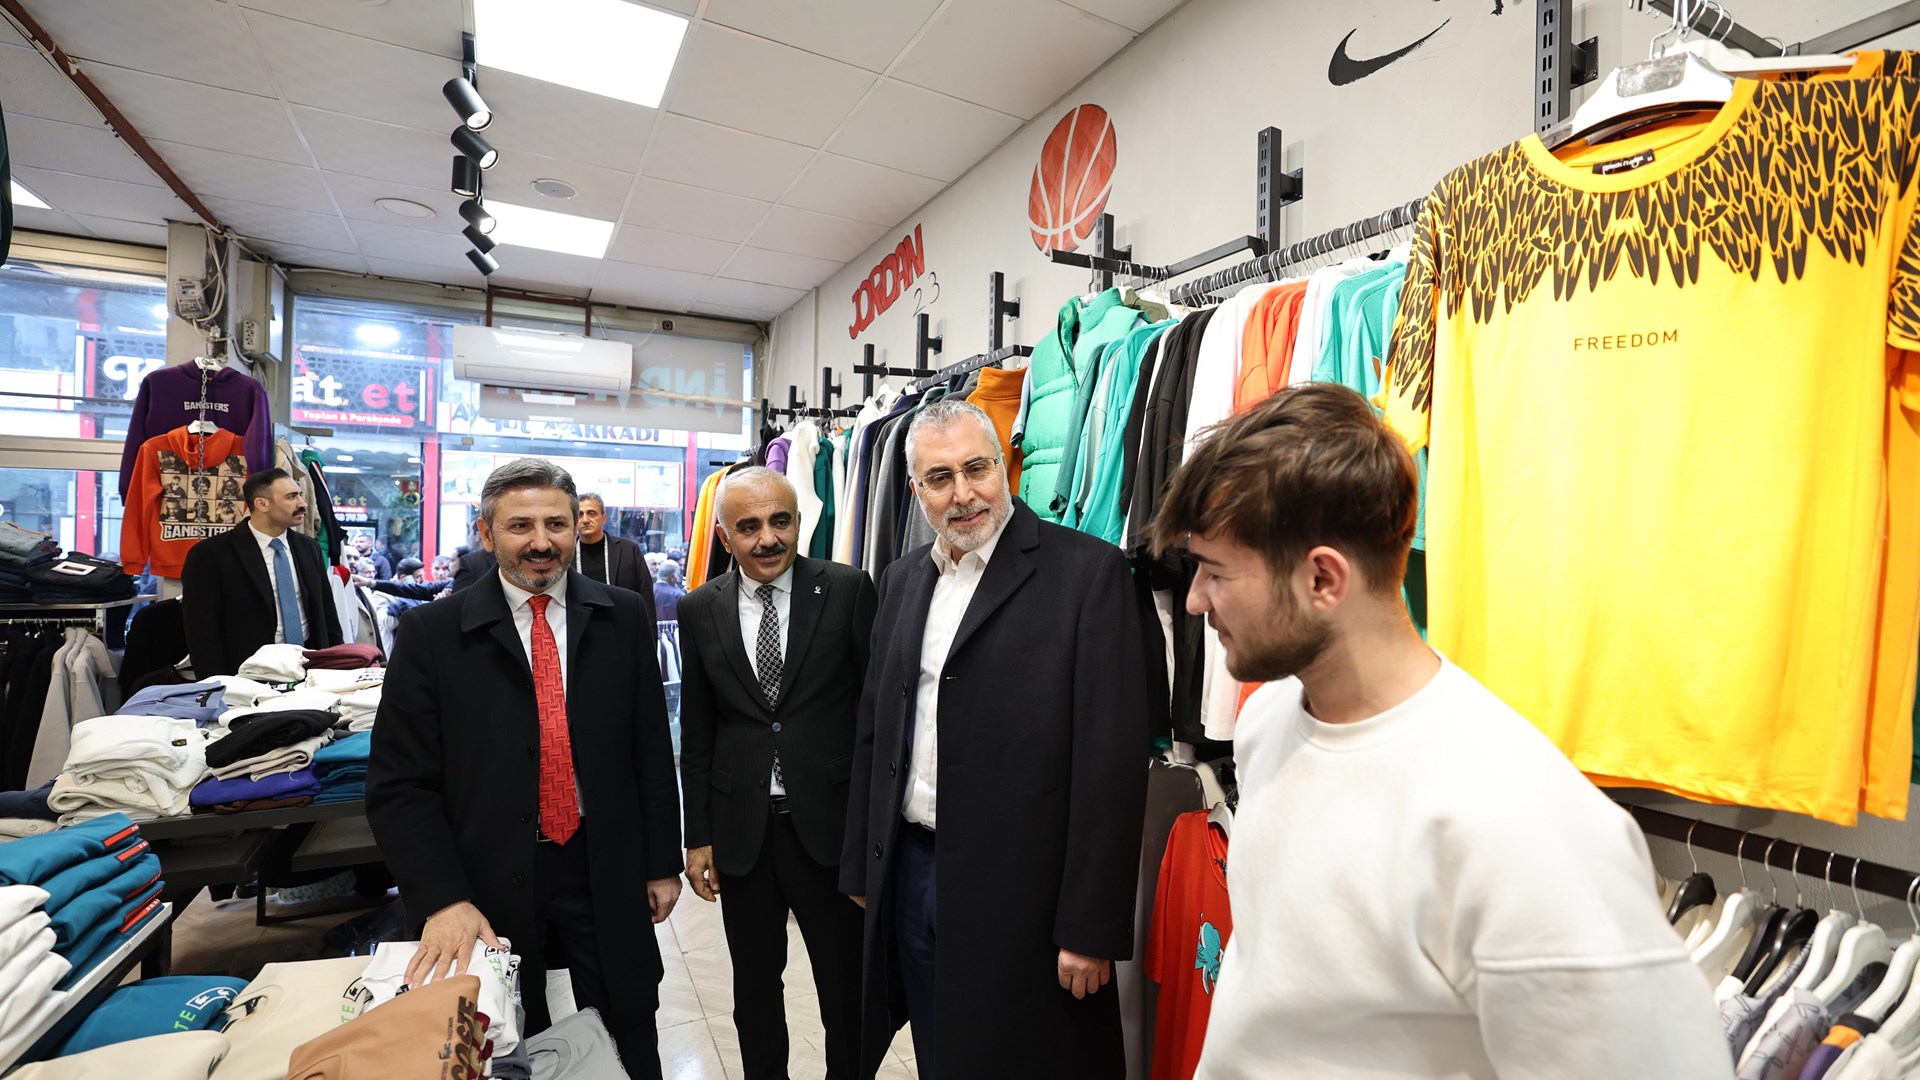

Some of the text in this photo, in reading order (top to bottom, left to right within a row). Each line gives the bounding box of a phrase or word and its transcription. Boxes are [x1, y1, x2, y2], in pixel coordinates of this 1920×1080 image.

[849, 222, 925, 339] JORDAN
[912, 271, 940, 317] 23
[1574, 329, 1678, 351] FREEDOM
[363, 381, 416, 411] et
[303, 410, 402, 425] Toptan & Perakende
[164, 525, 235, 539] GANGSTER
